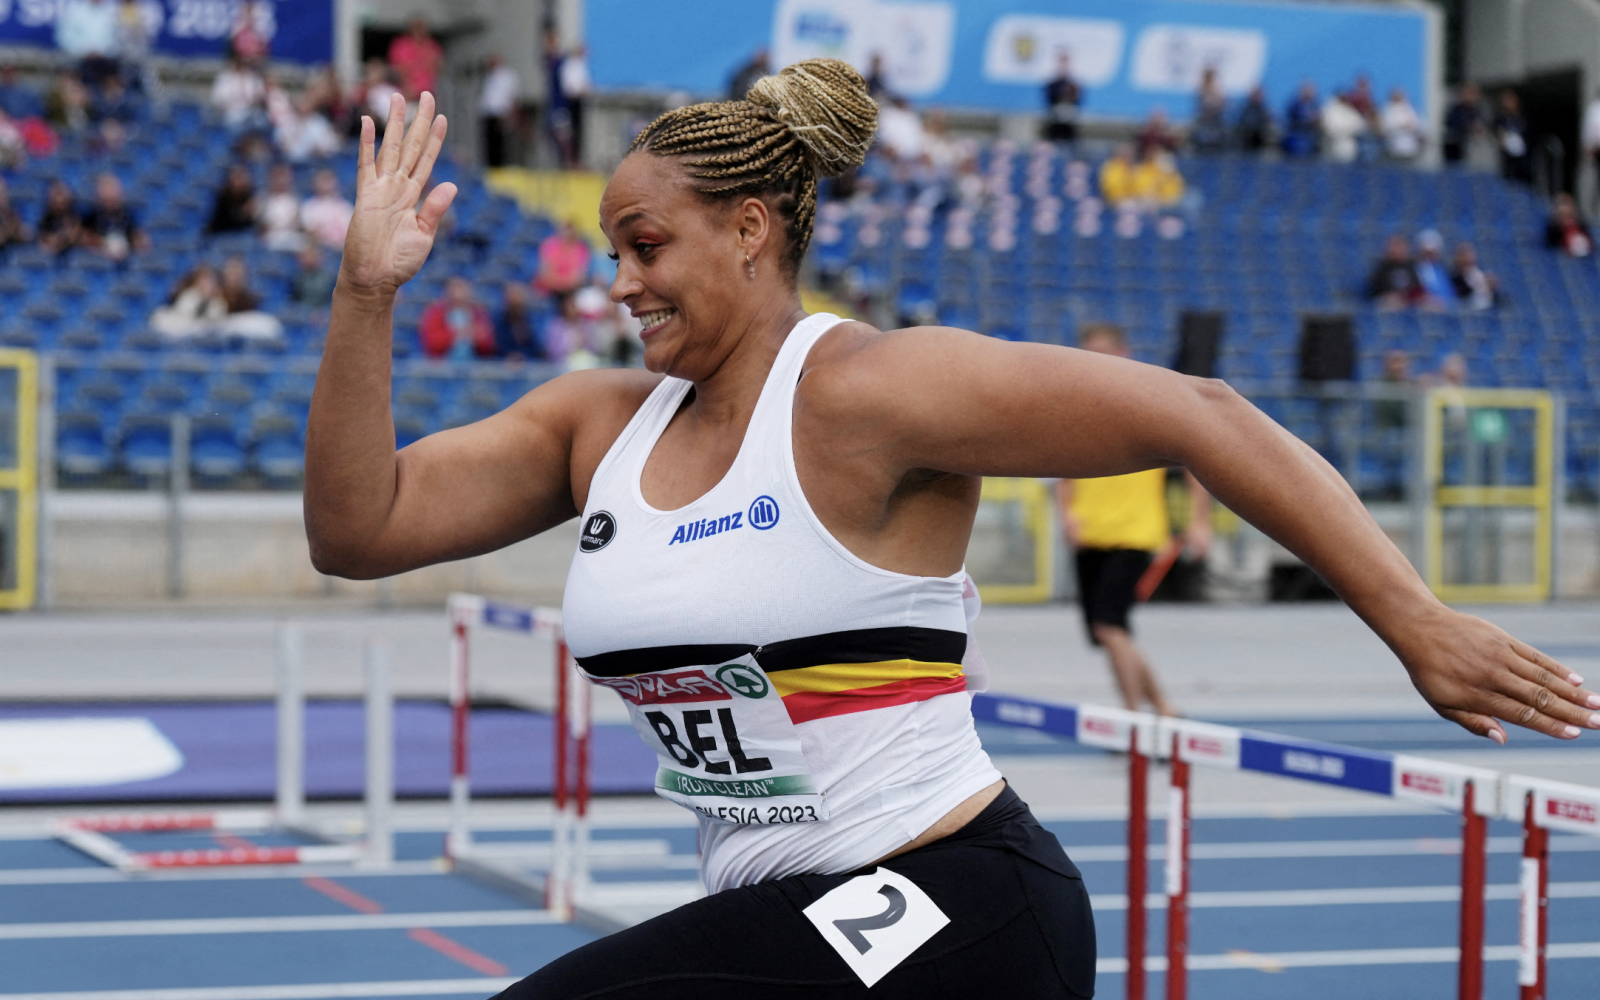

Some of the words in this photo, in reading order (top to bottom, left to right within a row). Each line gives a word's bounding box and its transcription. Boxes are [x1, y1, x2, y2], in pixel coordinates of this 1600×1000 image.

[668, 511, 743, 545] Allianz
[602, 676, 724, 700] SPAR
[645, 708, 773, 775] BEL
[682, 776, 714, 793] RUN
[767, 805, 819, 824] 2023
[832, 884, 907, 956] 2
